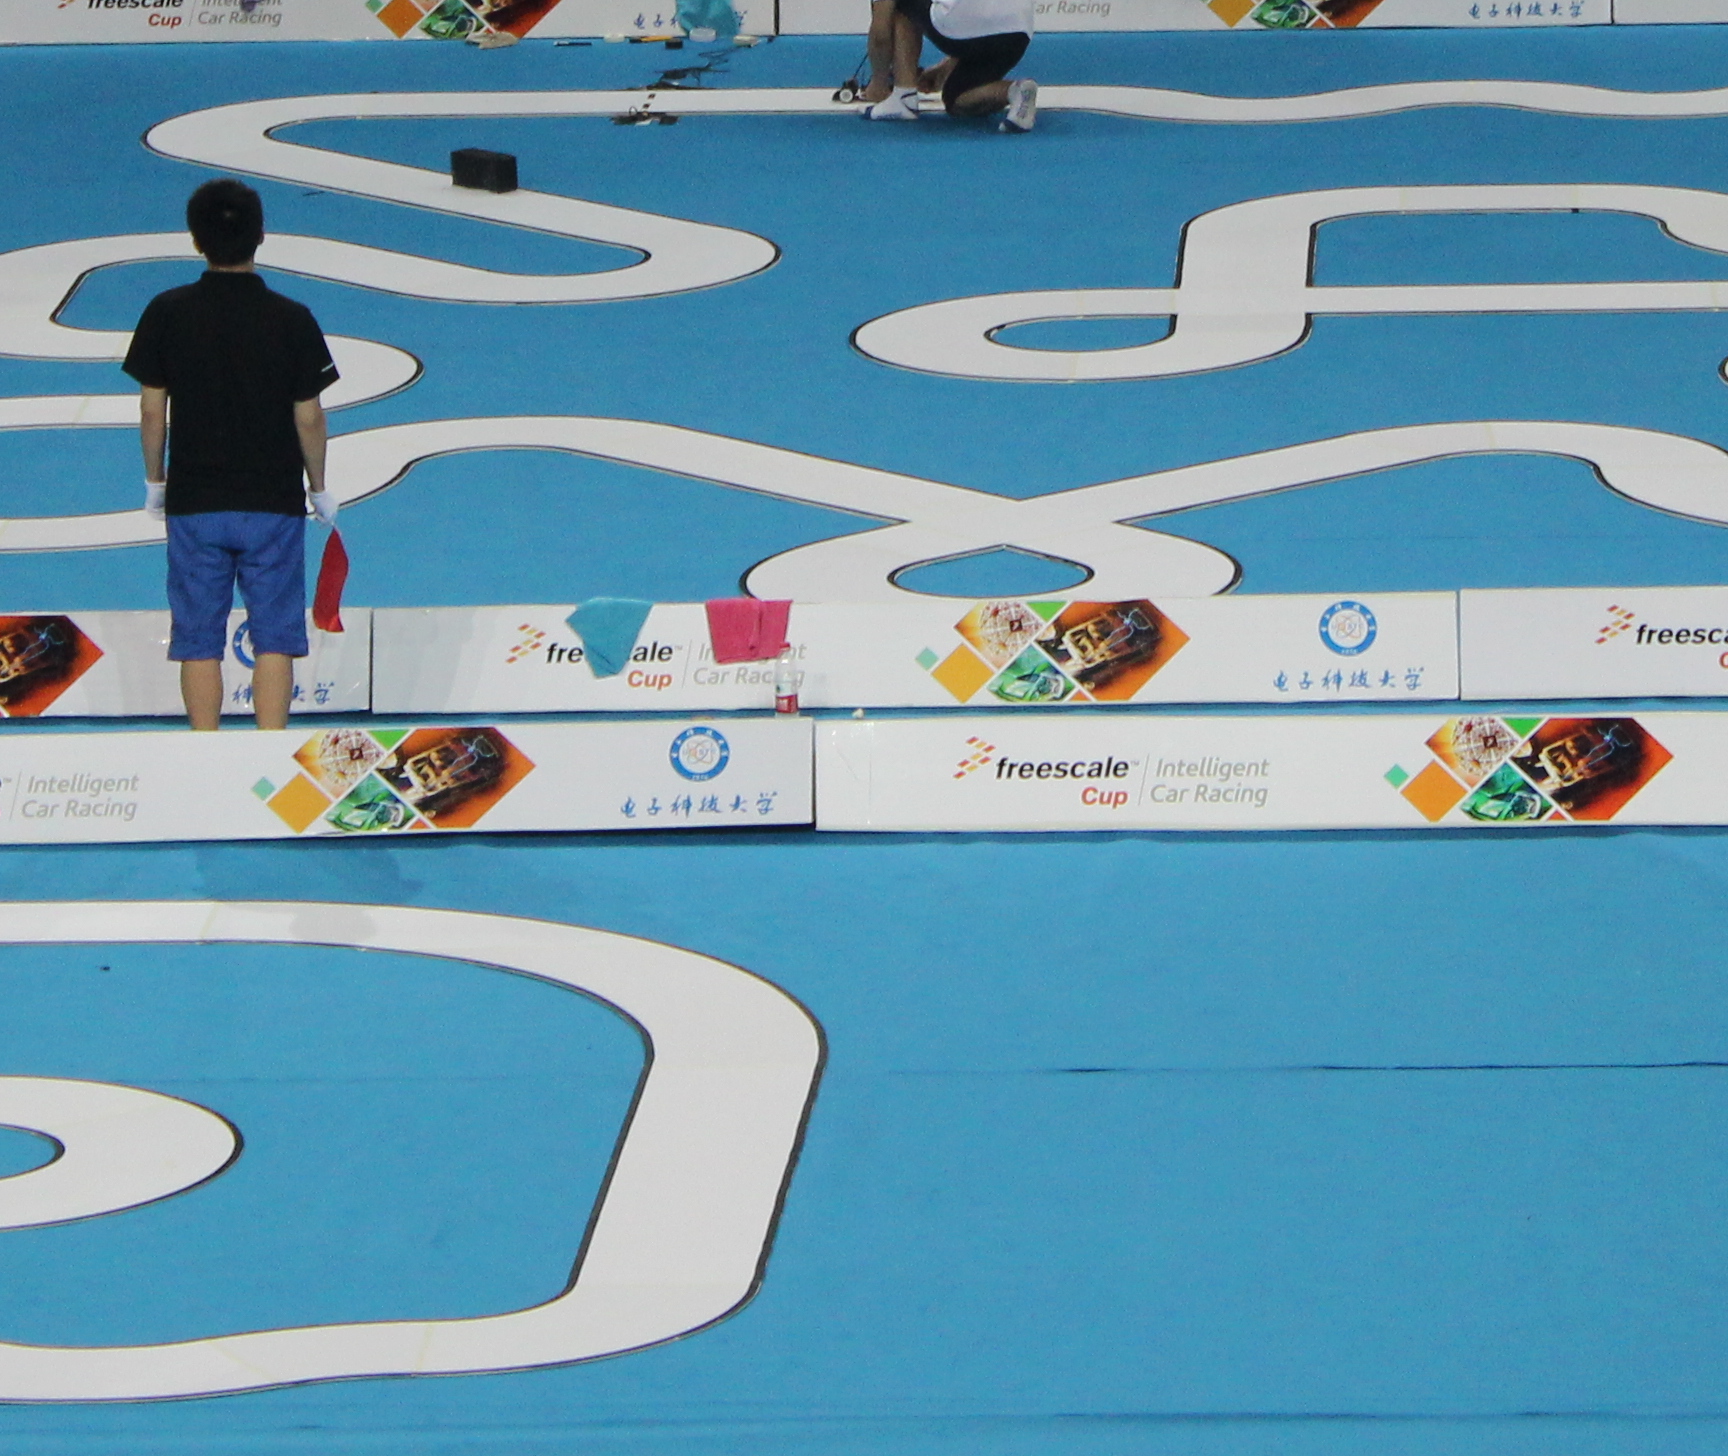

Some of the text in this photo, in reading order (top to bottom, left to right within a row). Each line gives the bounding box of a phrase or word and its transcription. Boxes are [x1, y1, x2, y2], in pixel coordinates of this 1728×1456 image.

[198, 10, 283, 27] Car Racing
[1057, 0, 1111, 17] Racing
[148, 13, 182, 29] Cup
[546, 641, 674, 664] freale
[627, 668, 673, 691] Cup
[693, 667, 728, 686] Car
[1273, 666, 1424, 693] 电子科技大学
[995, 754, 1130, 781] freescale
[1156, 757, 1270, 782] Intelligent
[27, 772, 140, 798] Intelligent
[1150, 783, 1269, 809] Car Racing
[21, 797, 139, 823] Car Racing
[619, 789, 779, 818] 电子科技大学
[1081, 786, 1128, 810] Cup
